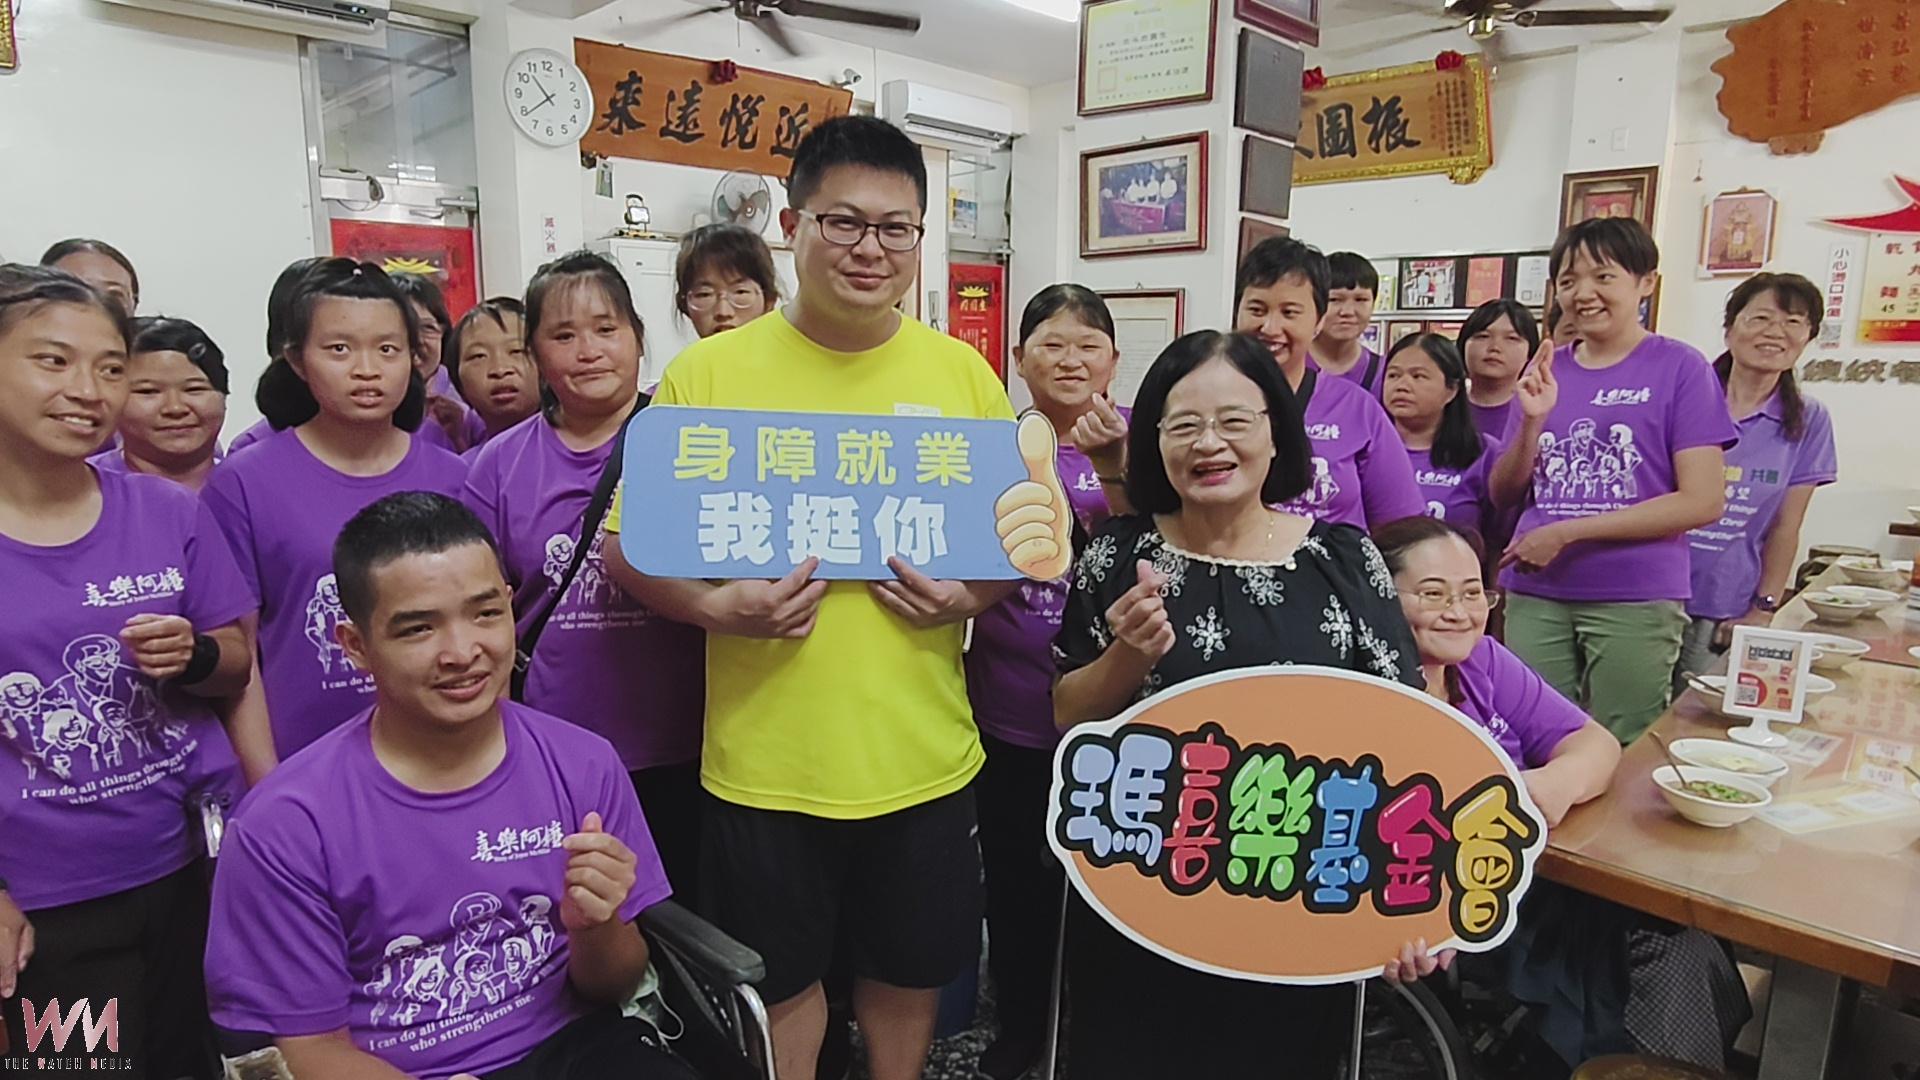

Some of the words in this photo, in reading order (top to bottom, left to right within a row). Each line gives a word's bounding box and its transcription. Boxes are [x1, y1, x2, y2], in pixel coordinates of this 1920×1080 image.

[527, 61, 537, 73] 11
[541, 60, 553, 72] 12
[517, 72, 530, 83] 10
[559, 67, 564, 78] 1
[569, 81, 577, 92] 2
[514, 87, 523, 98] 9
[574, 98, 581, 109] 3
[520, 105, 529, 116] 8
[532, 119, 539, 129] 7
[569, 114, 577, 123] 4
[546, 126, 554, 136] 6
[561, 124, 568, 134] 5
[673, 422, 974, 487] 身障就業
[698, 492, 948, 566] 我挺你
[321, 680, 327, 690] I
[349, 676, 363, 686] do
[22, 788, 28, 799] I
[32, 787, 57, 798] can
[59, 784, 77, 797] do
[79, 781, 97, 794] all
[99, 769, 142, 788] things
[69, 794, 98, 805] who
[1066, 732, 1530, 935] 瑪喜樂基金會
[409, 1036, 437, 1053] who
[440, 1003, 514, 1043] strengthens
[369, 1040, 375, 1051] I
[377, 1037, 398, 1049] can
[400, 1030, 417, 1043] do
[419, 1022, 436, 1036] all
